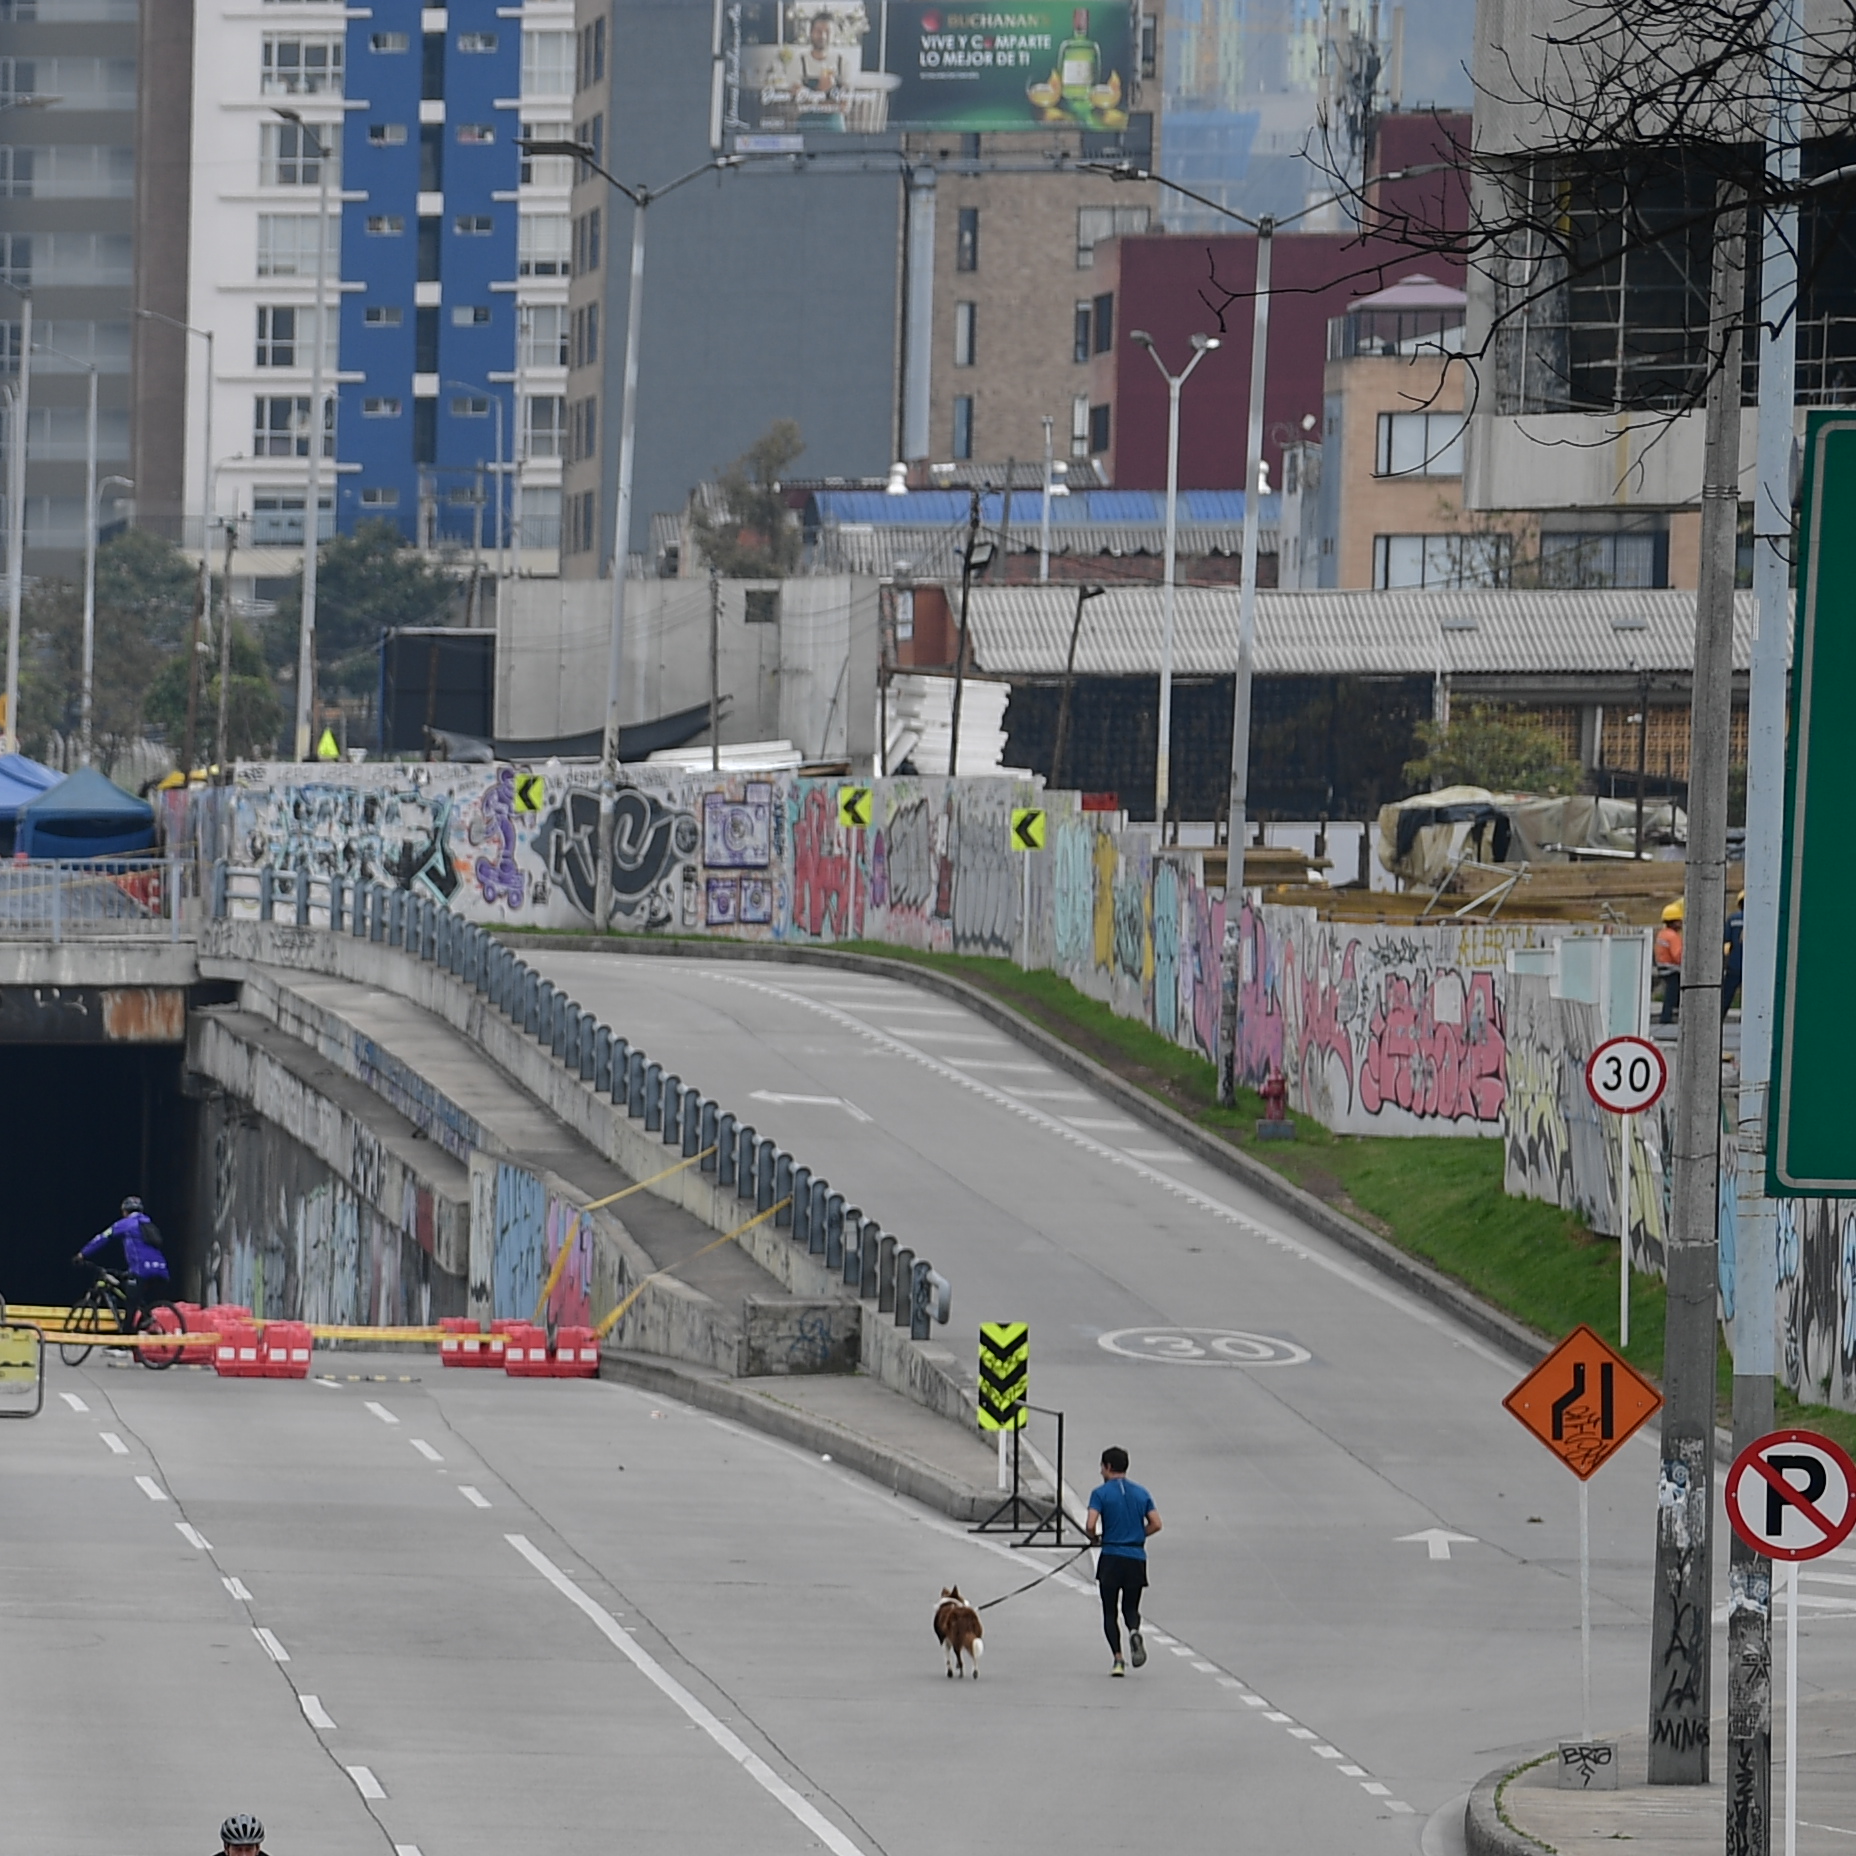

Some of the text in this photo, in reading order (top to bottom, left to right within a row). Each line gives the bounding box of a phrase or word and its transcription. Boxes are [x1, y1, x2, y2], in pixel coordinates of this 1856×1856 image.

[921, 34, 955, 50] VIVE
[957, 34, 968, 50] Y
[919, 51, 940, 67] LO
[943, 51, 993, 67] MEJOR
[996, 51, 1015, 67] DE
[1602, 1056, 1651, 1093] 30
[1143, 1335, 1275, 1360] 30
